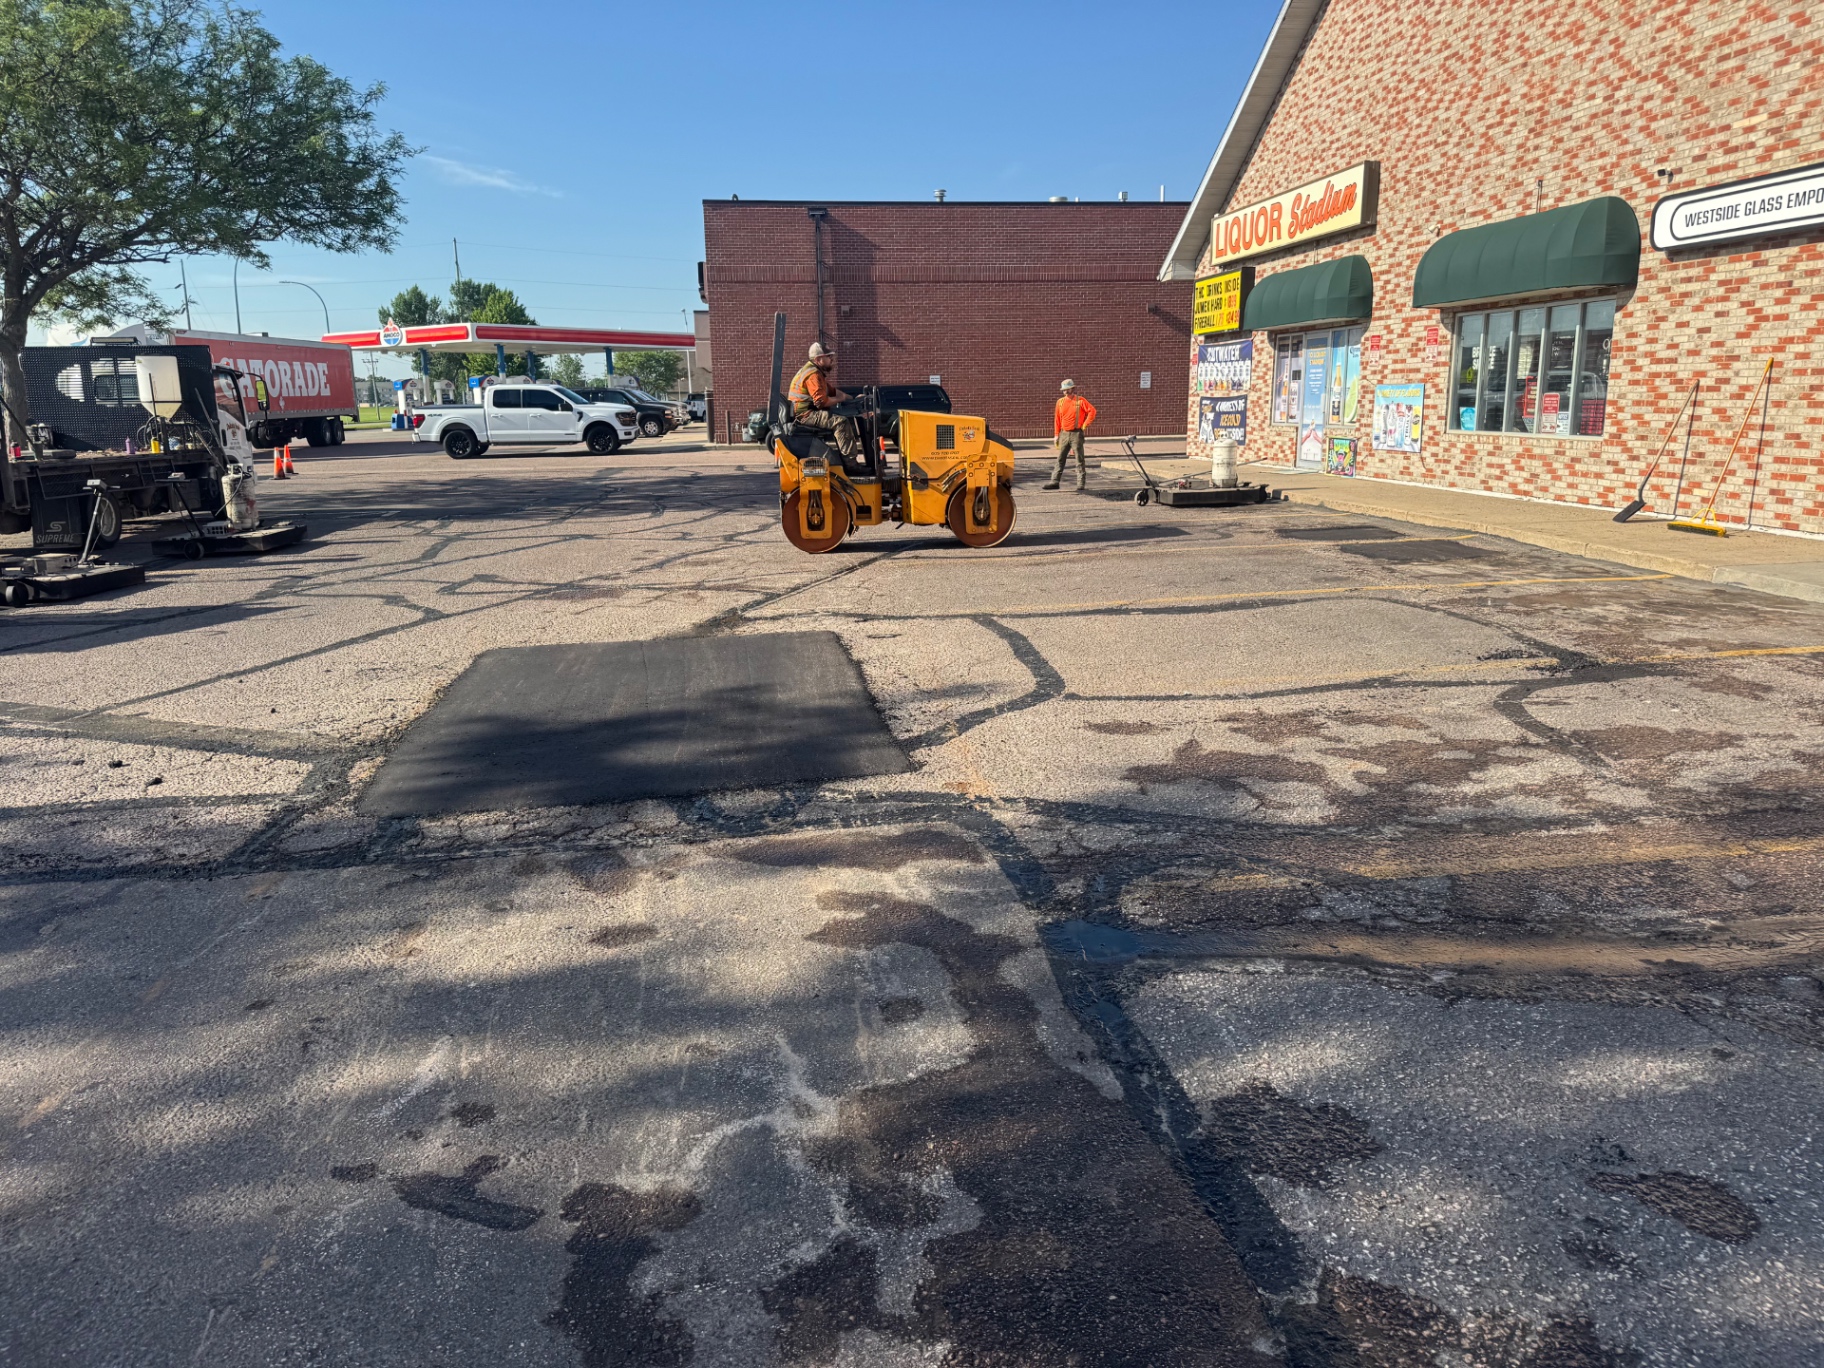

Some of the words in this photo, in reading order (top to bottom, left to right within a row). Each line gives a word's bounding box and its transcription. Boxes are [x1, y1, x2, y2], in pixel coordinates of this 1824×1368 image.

[1215, 202, 1283, 259] LIQUOR
[1287, 180, 1357, 240] Stadium
[1684, 203, 1741, 228] WESTSIDE
[1744, 195, 1783, 217] GLASS
[1224, 277, 1240, 293] INSIDE
[219, 357, 331, 399] GATORADE
[36, 533, 75, 544] SUPREME
